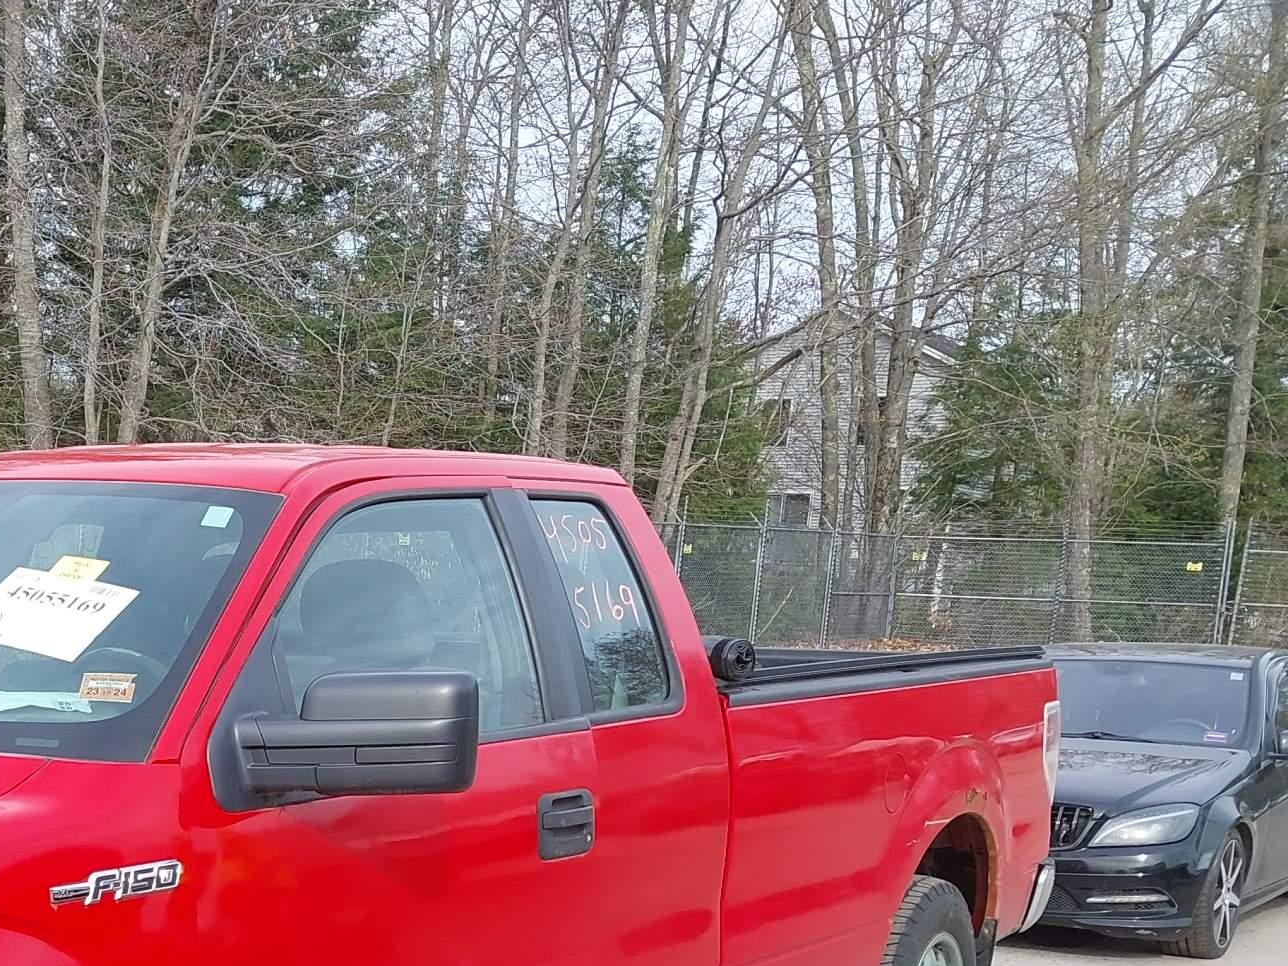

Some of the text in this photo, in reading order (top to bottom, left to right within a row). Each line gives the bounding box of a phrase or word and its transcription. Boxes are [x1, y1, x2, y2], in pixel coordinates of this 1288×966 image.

[536, 512, 608, 564] 4505
[7, 585, 107, 614] 45055169
[573, 579, 642, 630] 5169
[86, 687, 99, 695] 23
[113, 688, 127, 697] 24
